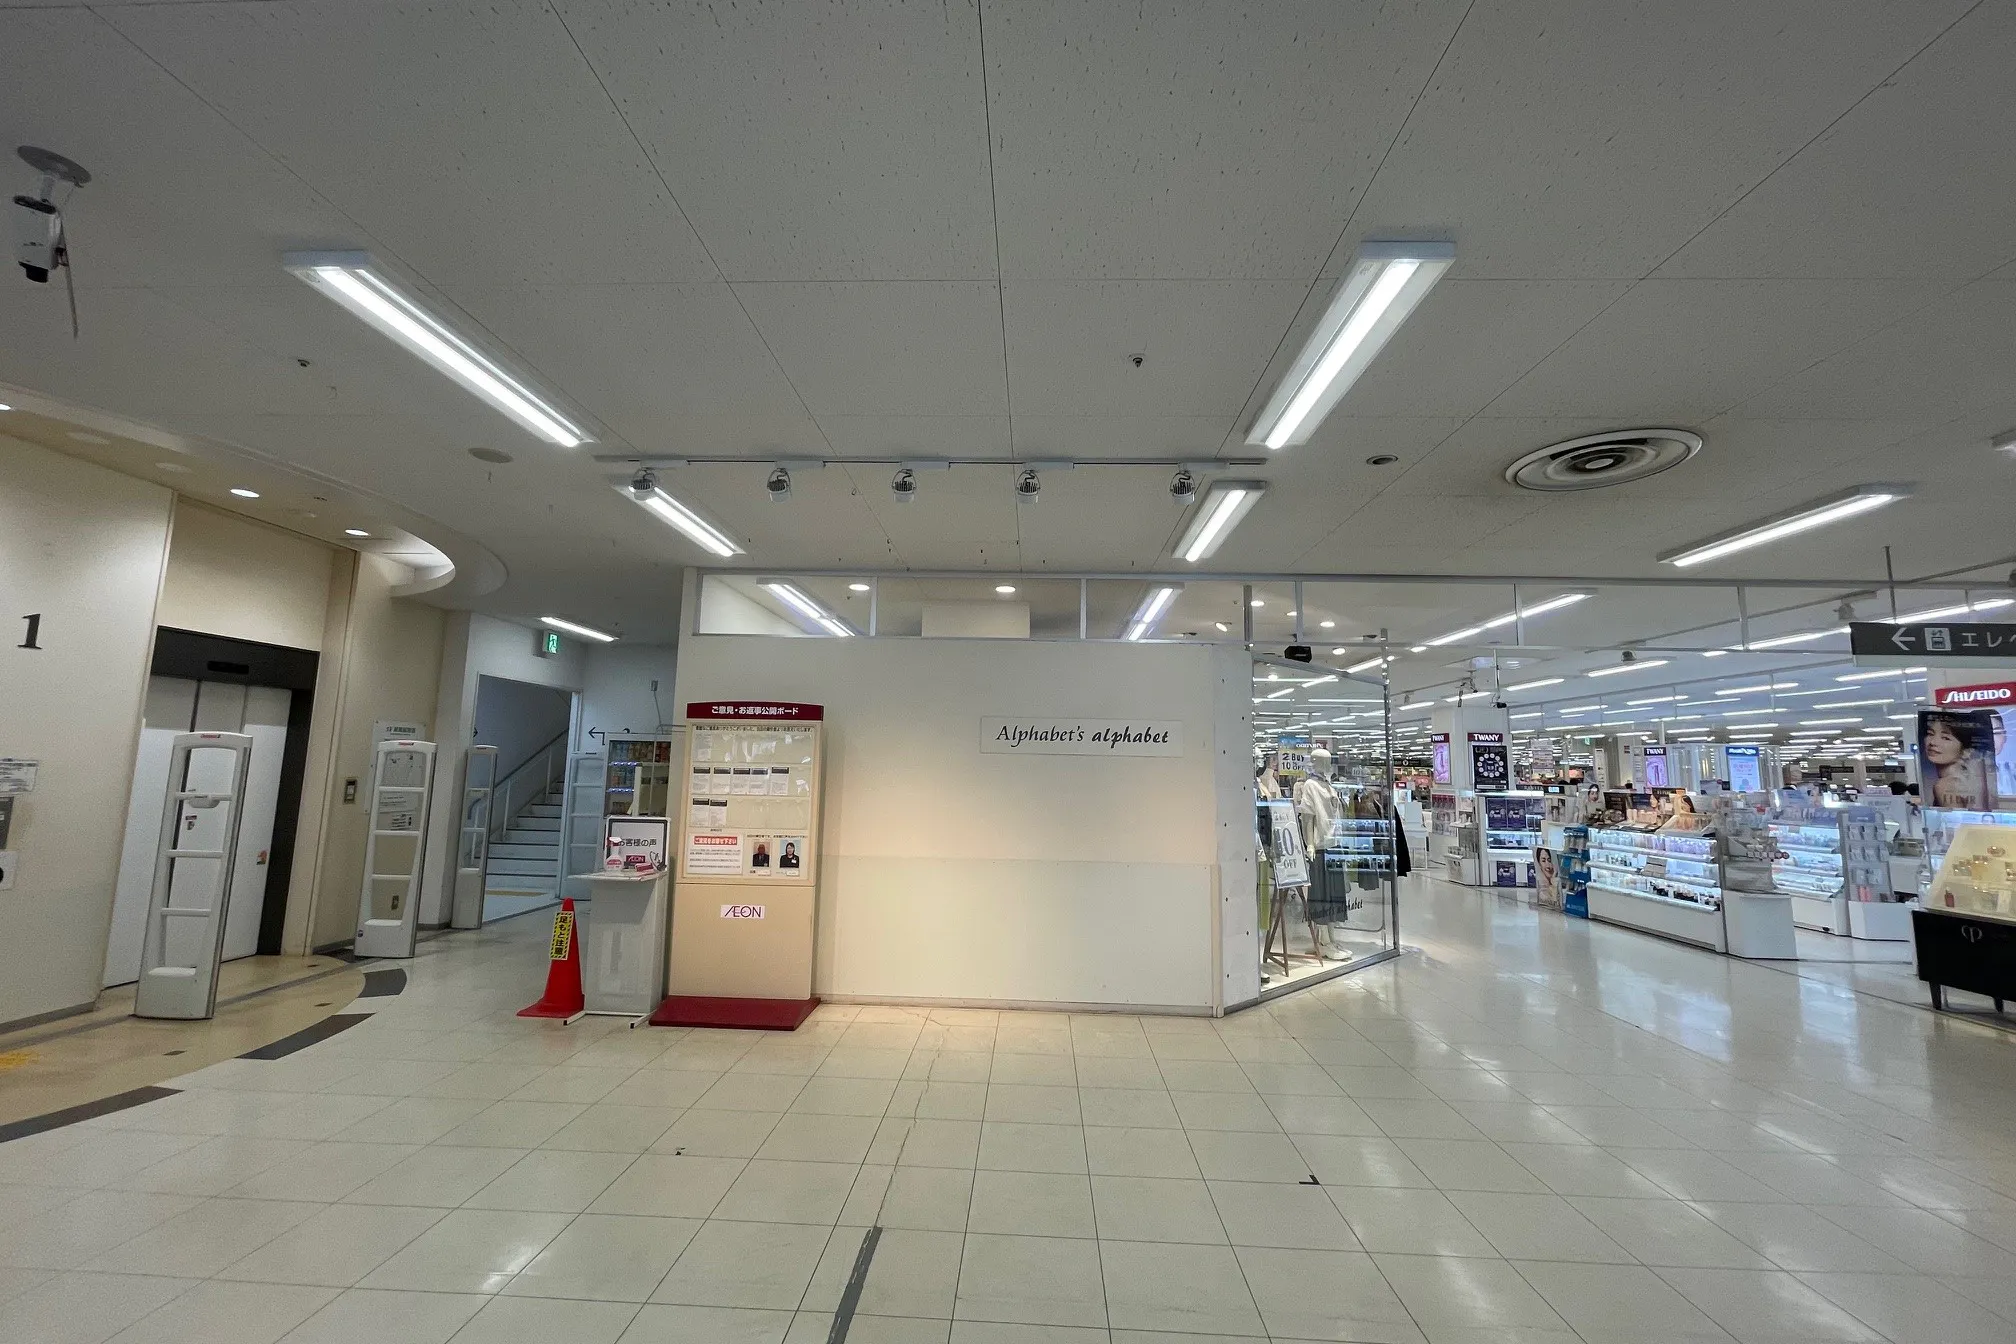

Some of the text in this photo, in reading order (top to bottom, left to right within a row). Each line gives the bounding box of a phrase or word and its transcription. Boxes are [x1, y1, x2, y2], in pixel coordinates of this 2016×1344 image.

[17, 613, 43, 650] 1
[1941, 688, 2011, 704] SHISEIDO
[995, 725, 1169, 749] Alphabet's alphabet
[1473, 733, 1500, 742] TWANY
[554, 915, 568, 955] 足もと注意
